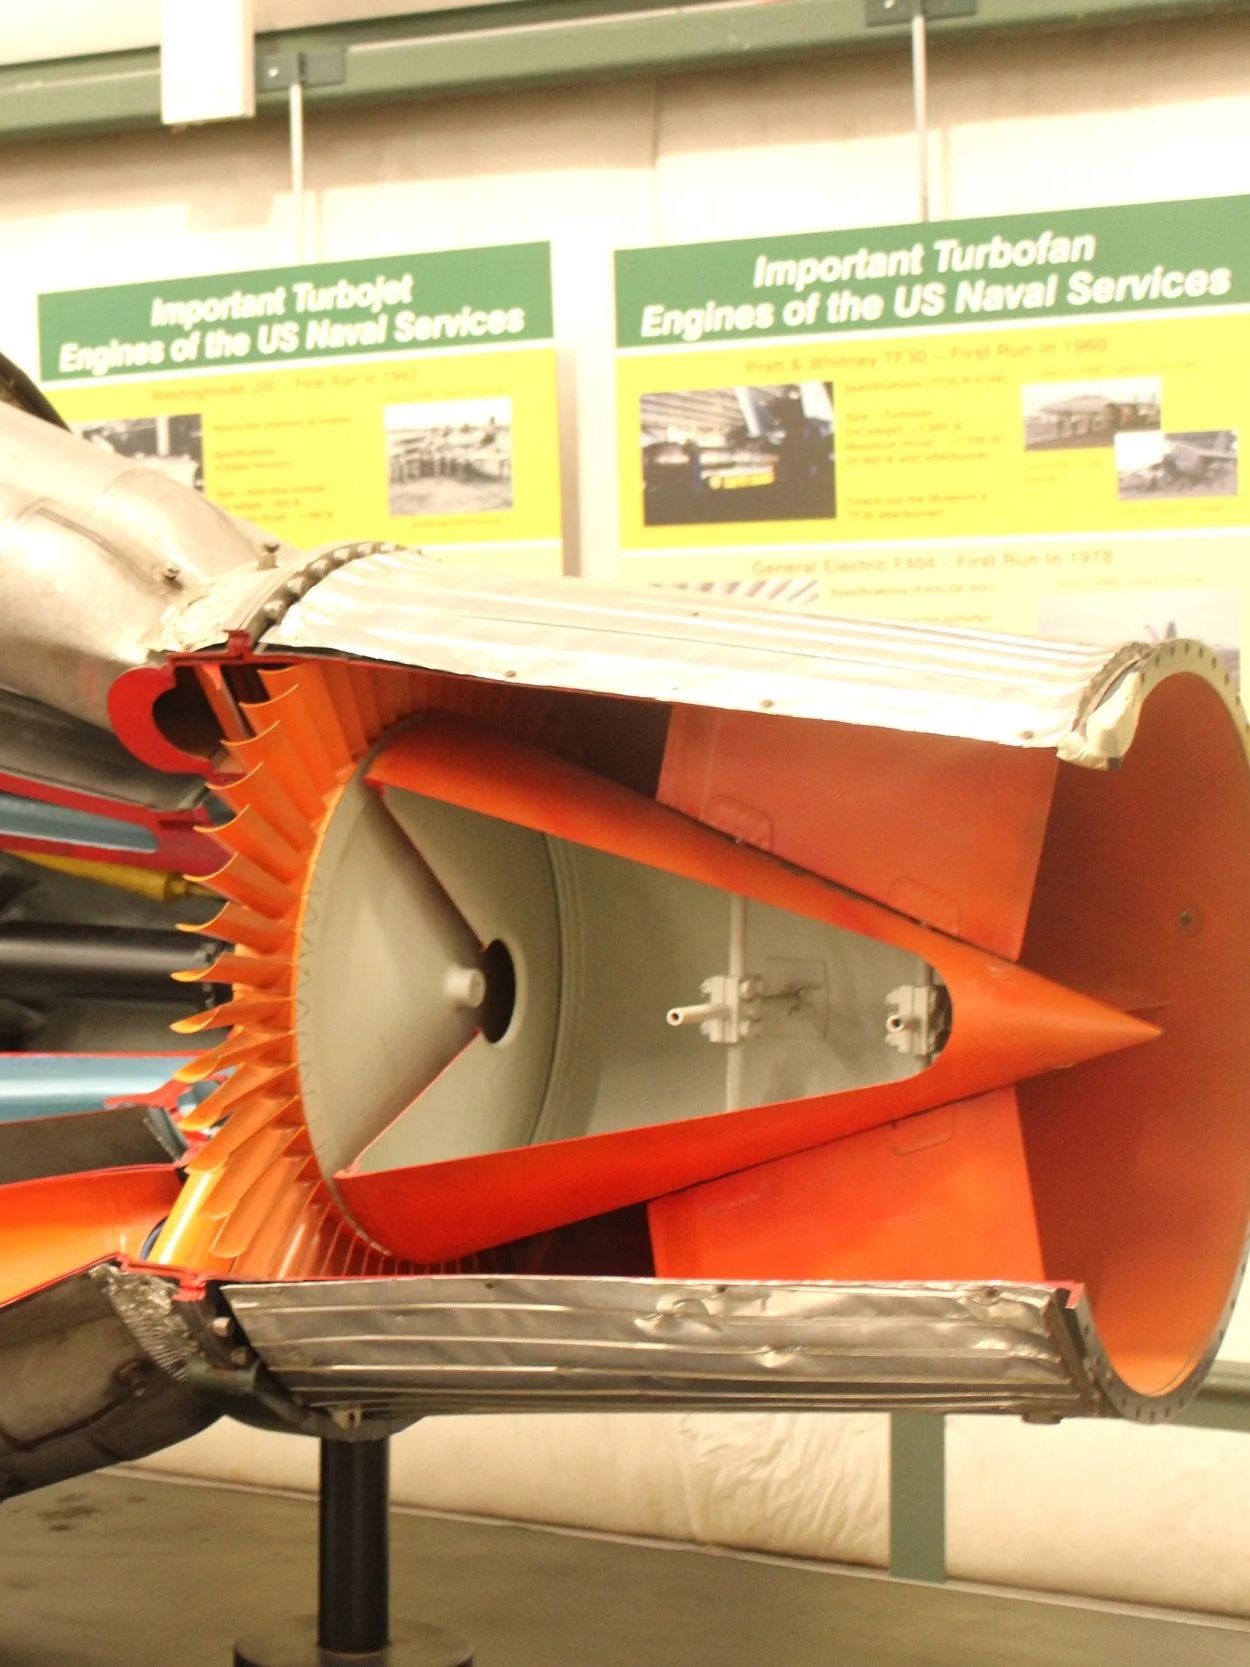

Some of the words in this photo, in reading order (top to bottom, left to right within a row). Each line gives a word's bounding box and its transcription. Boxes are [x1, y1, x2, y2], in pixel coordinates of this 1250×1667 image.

[753, 243, 925, 293] Important
[933, 229, 1096, 273] Turbofan
[150, 285, 287, 331] Important
[292, 272, 414, 314] Turbojet
[641, 300, 775, 342] Engines
[782, 291, 821, 326] of
[826, 290, 884, 323] the
[894, 282, 946, 318] US
[954, 274, 1058, 313] Naval
[1066, 264, 1232, 306] Services
[58, 337, 165, 376] Engines
[169, 330, 201, 362] of
[204, 328, 251, 359] the
[257, 321, 300, 354] US
[305, 314, 389, 350] Naval
[393, 305, 526, 343] Services
[745, 359, 784, 374] Pratt
[792, 358, 801, 372] &
[810, 354, 877, 371] Whitney
[952, 345, 990, 360] First
[998, 343, 1033, 357] Run
[1040, 341, 1056, 355] In
[1064, 338, 1108, 354] 1960
[752, 560, 817, 577] General
[823, 559, 888, 575] Electric
[894, 556, 935, 571] F404
[957, 554, 996, 569] First
[1003, 553, 1039, 567] Run
[1046, 552, 1062, 566] In
[1070, 550, 1113, 565] 1978
